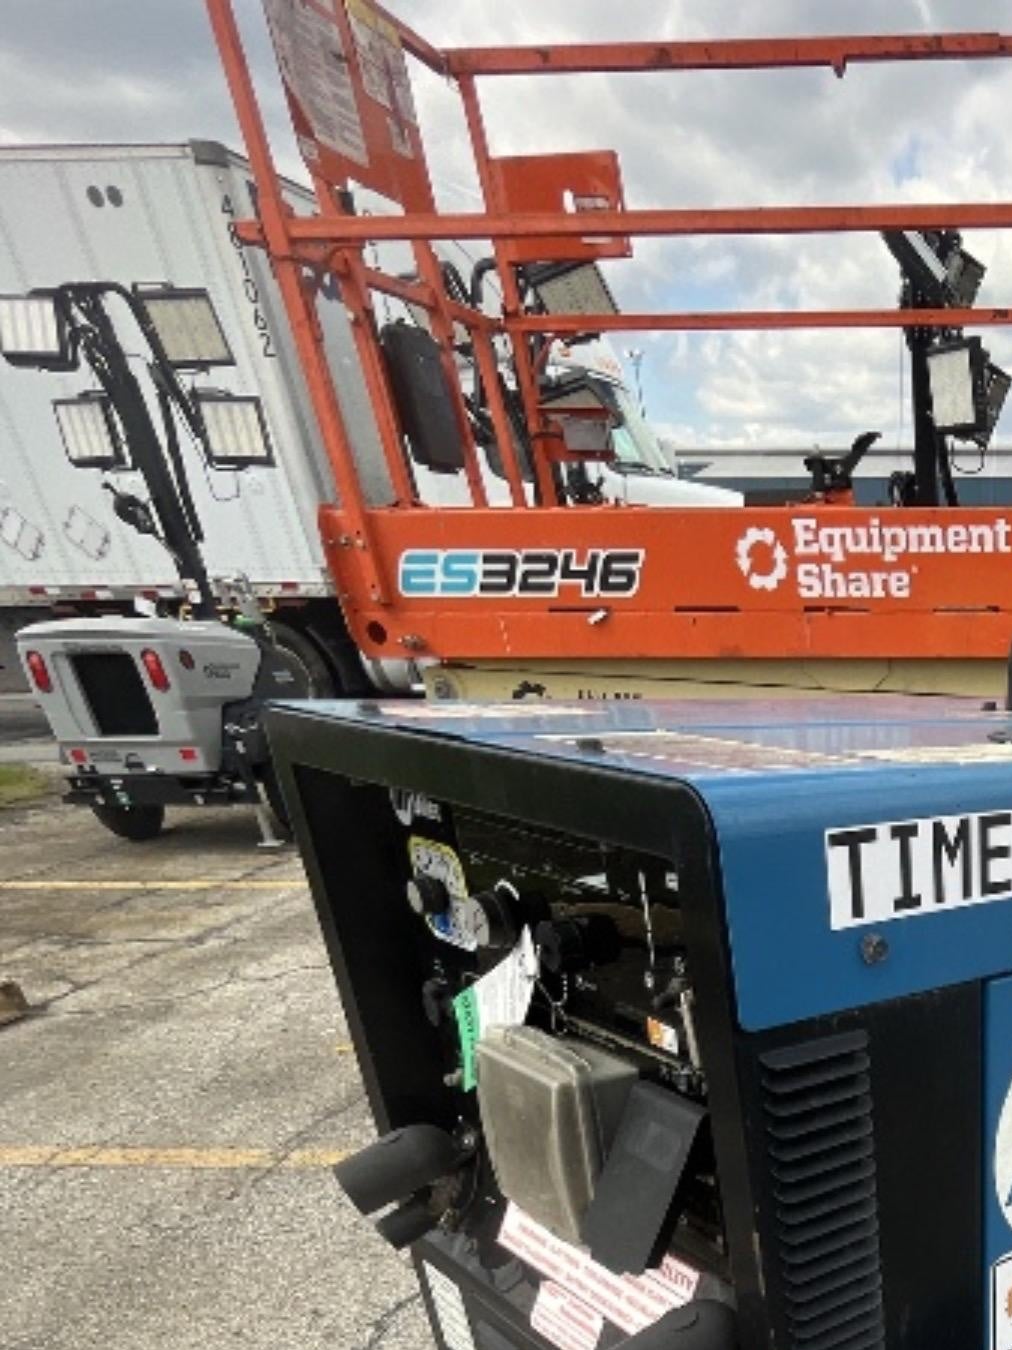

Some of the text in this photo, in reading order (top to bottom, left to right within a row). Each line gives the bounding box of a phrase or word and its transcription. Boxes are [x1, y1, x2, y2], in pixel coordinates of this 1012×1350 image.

[791, 516, 1012, 562] Equipment
[398, 549, 645, 598] ES3246
[797, 562, 911, 598] Share
